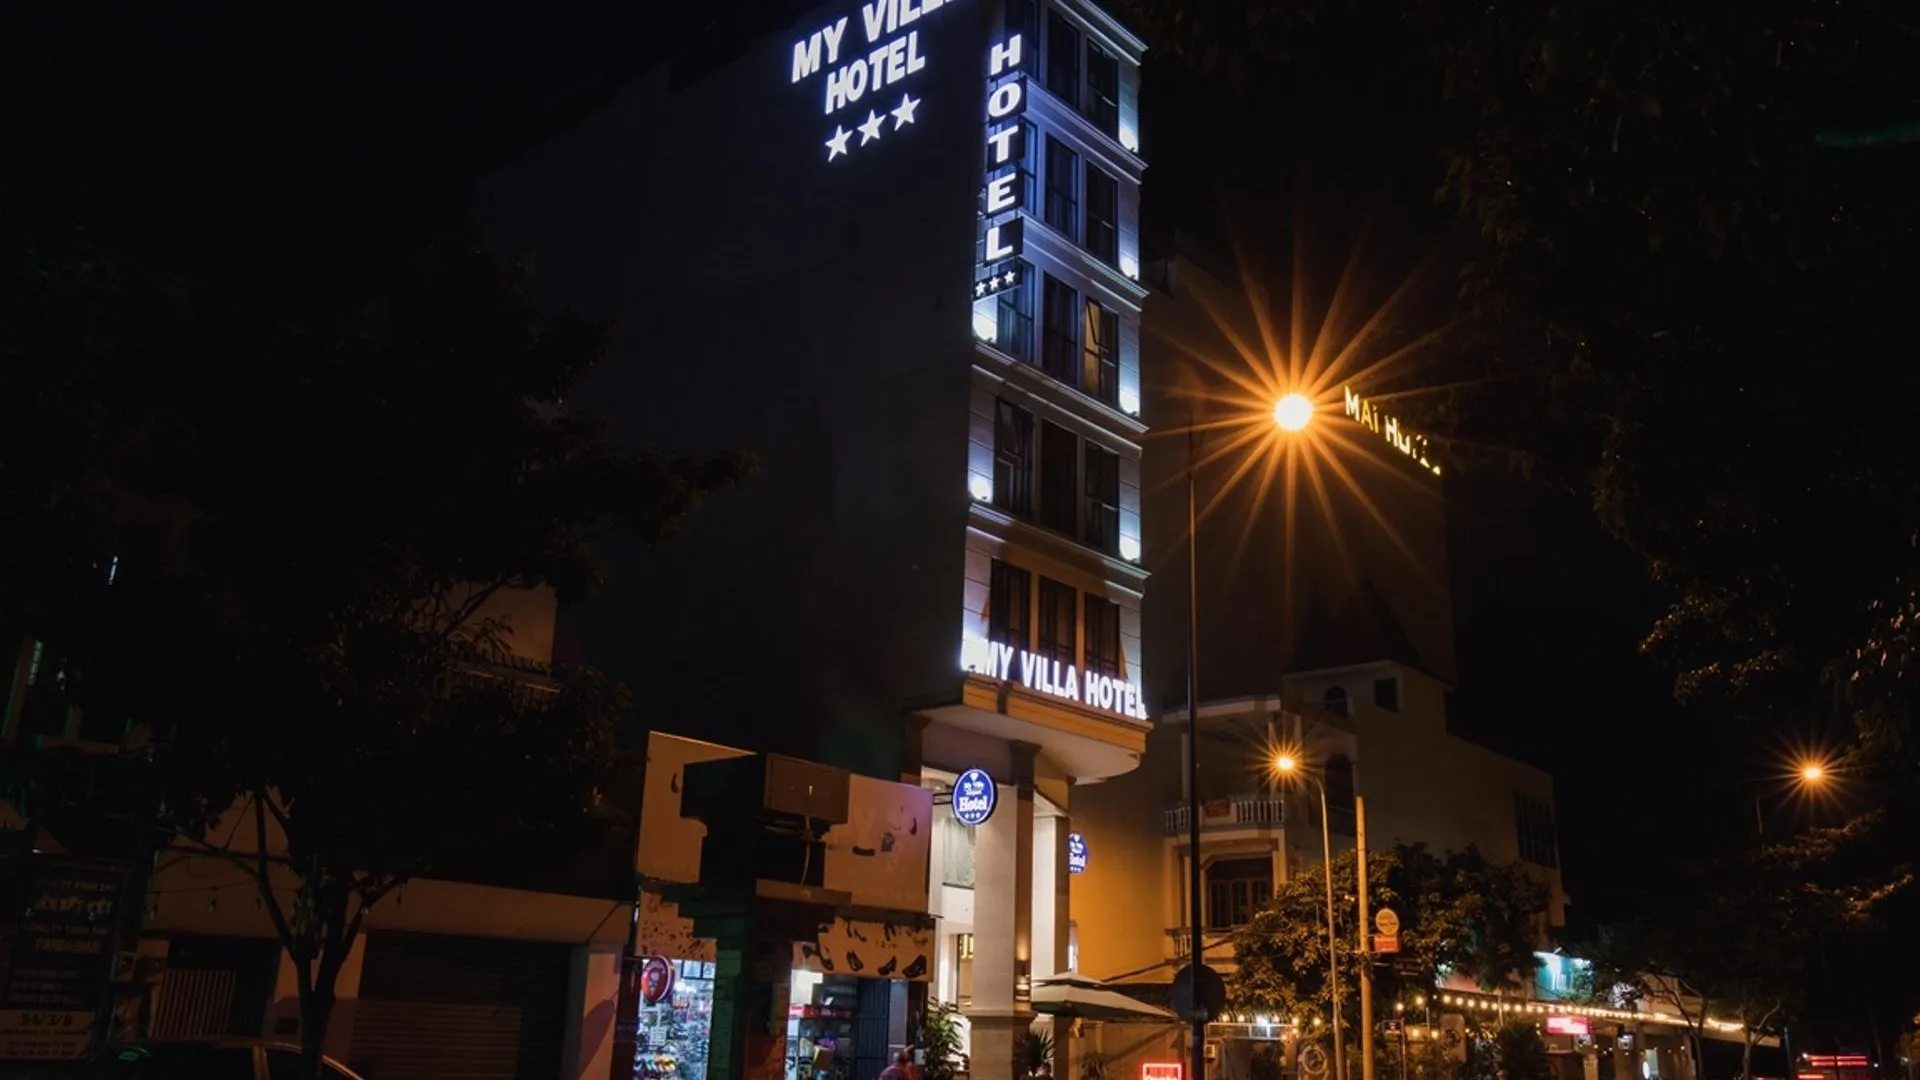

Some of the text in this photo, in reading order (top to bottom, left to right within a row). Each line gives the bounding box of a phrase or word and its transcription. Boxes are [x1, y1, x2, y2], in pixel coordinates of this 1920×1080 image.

[792, 0, 952, 83] MY VIL
[825, 30, 925, 115] HOTEL
[986, 34, 1022, 262] HOTEL
[978, 638, 1147, 721] MY VILLA HOTEL
[959, 795, 988, 812] Hotel
